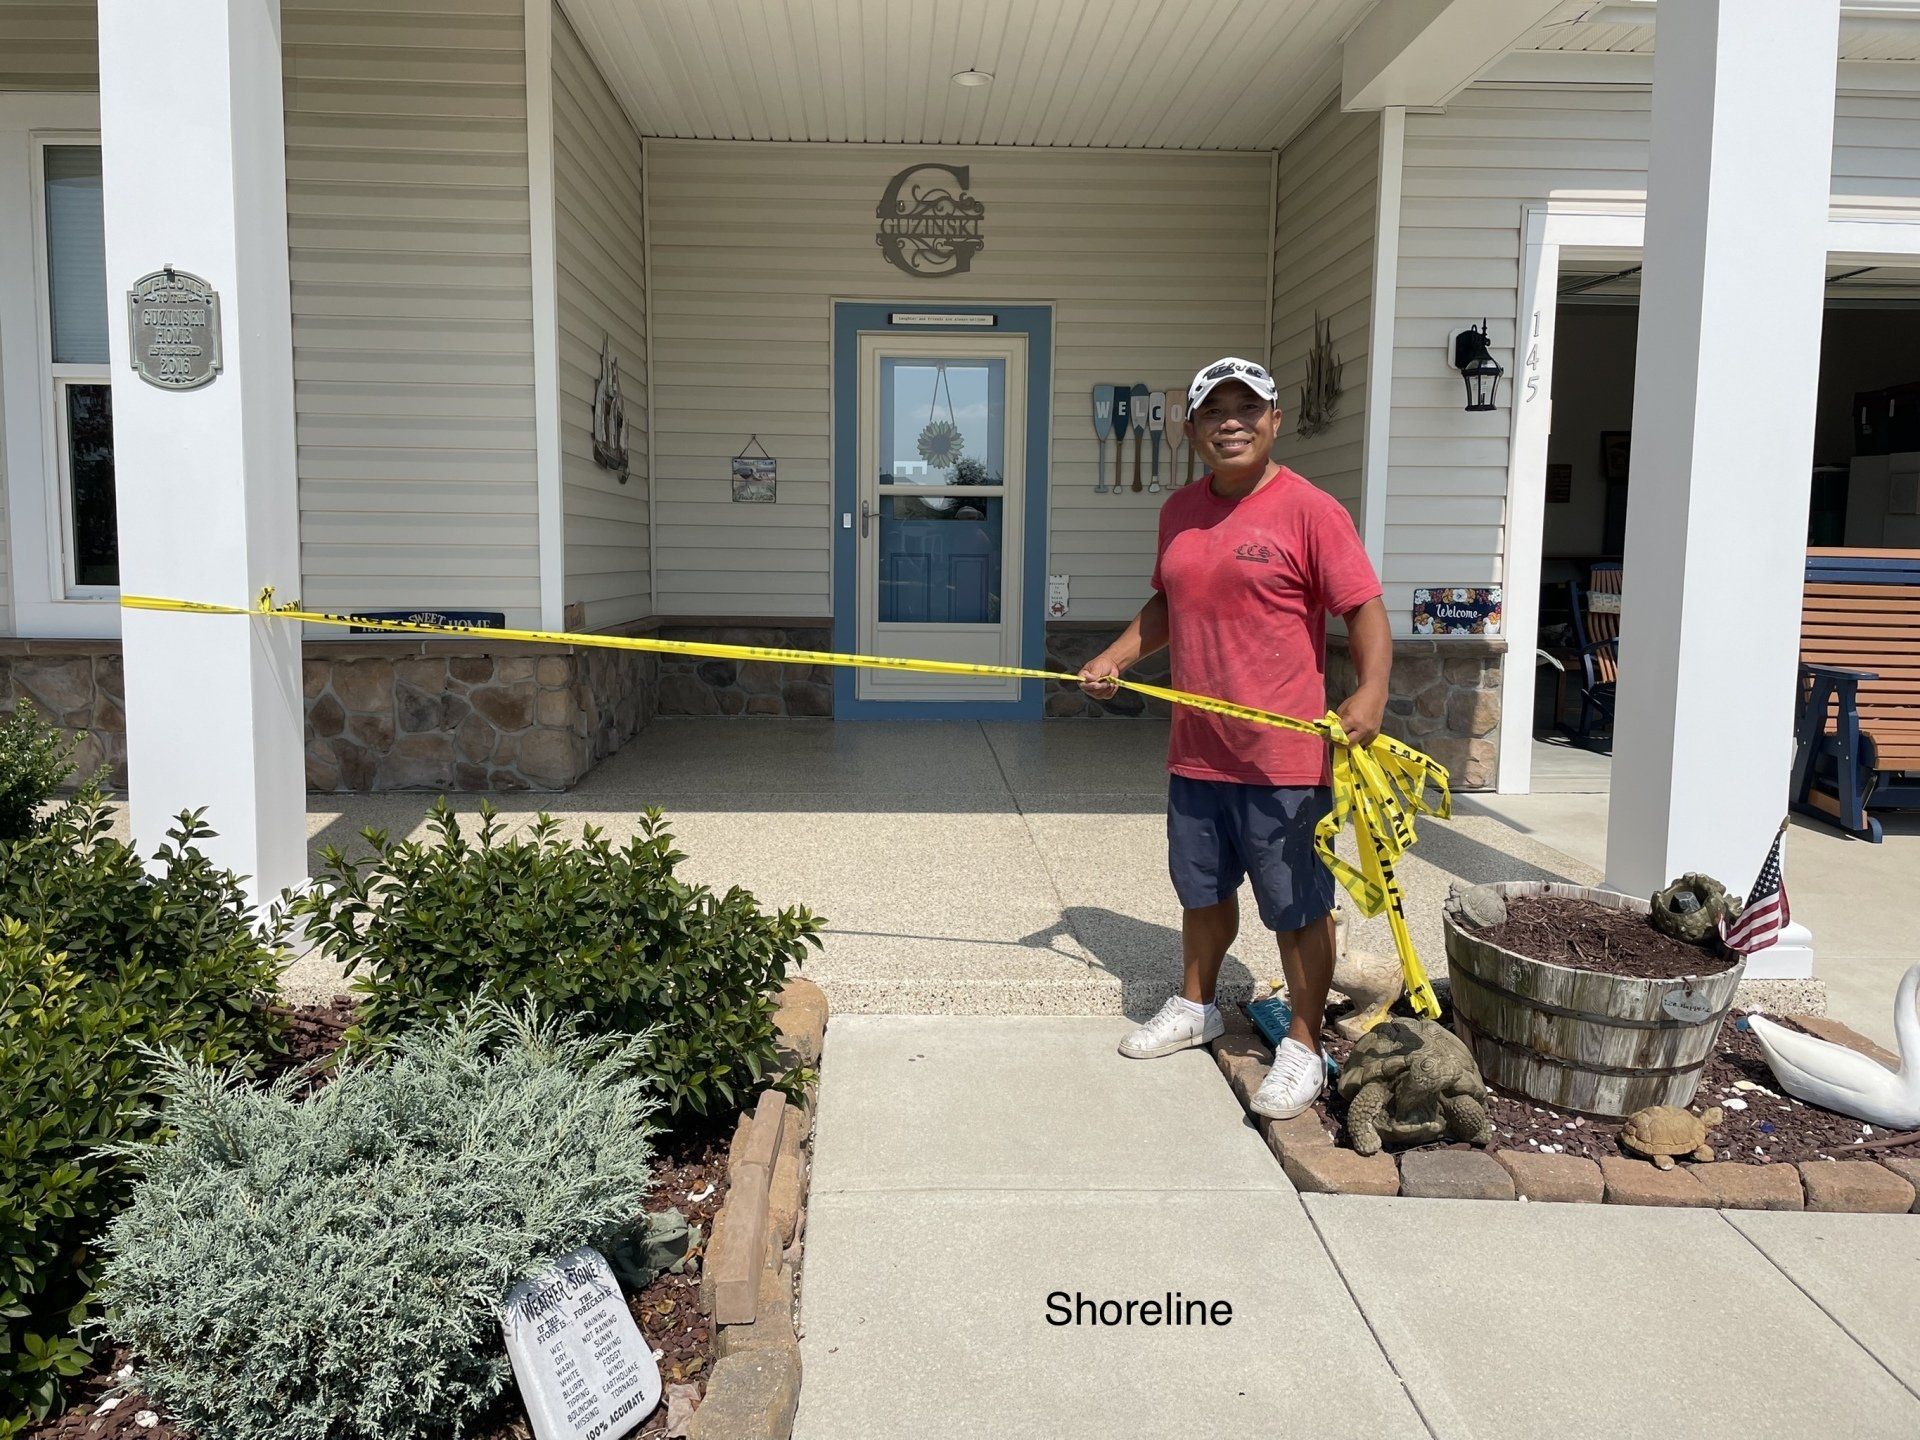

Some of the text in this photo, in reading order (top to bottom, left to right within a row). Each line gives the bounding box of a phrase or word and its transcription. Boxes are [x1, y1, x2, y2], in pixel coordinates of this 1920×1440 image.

[881, 217, 980, 236] GUZINSKI
[140, 276, 206, 298] WELCOME
[156, 292, 169, 303] TO
[143, 308, 205, 326] GUZINSKI
[156, 327, 192, 344] HOME
[160, 357, 191, 374] 2016
[1096, 401, 1183, 422] WELCO
[408, 612, 446, 625] SWEET
[1436, 604, 1482, 618] Welcome
[520, 1263, 598, 1323] WEATHER STONE
[579, 1291, 594, 1305] THE
[573, 1292, 606, 1319] FORECAST
[537, 1314, 560, 1335] IF THE
[581, 1314, 618, 1344] NOT RAINING
[583, 1309, 607, 1329] RAINING
[537, 1325, 561, 1345] STONE
[593, 1329, 613, 1348] SUNNY
[549, 1340, 563, 1355] WET
[594, 1336, 622, 1360] SNOWING
[554, 1351, 567, 1365] DRY
[555, 1359, 576, 1377] WARM
[602, 1349, 621, 1367] FOGGY
[606, 1358, 626, 1377] WINDY
[560, 1368, 580, 1387] WHITE
[602, 1361, 639, 1393] EARTHQUAKE
[610, 1374, 638, 1399] TORNADO
[562, 1378, 585, 1399] BLURRY
[566, 1387, 590, 1408] TIPPING
[567, 1394, 598, 1423] BOUNCING
[574, 1406, 600, 1431] MISSING
[585, 1390, 645, 1440] 100% ACCURATE
